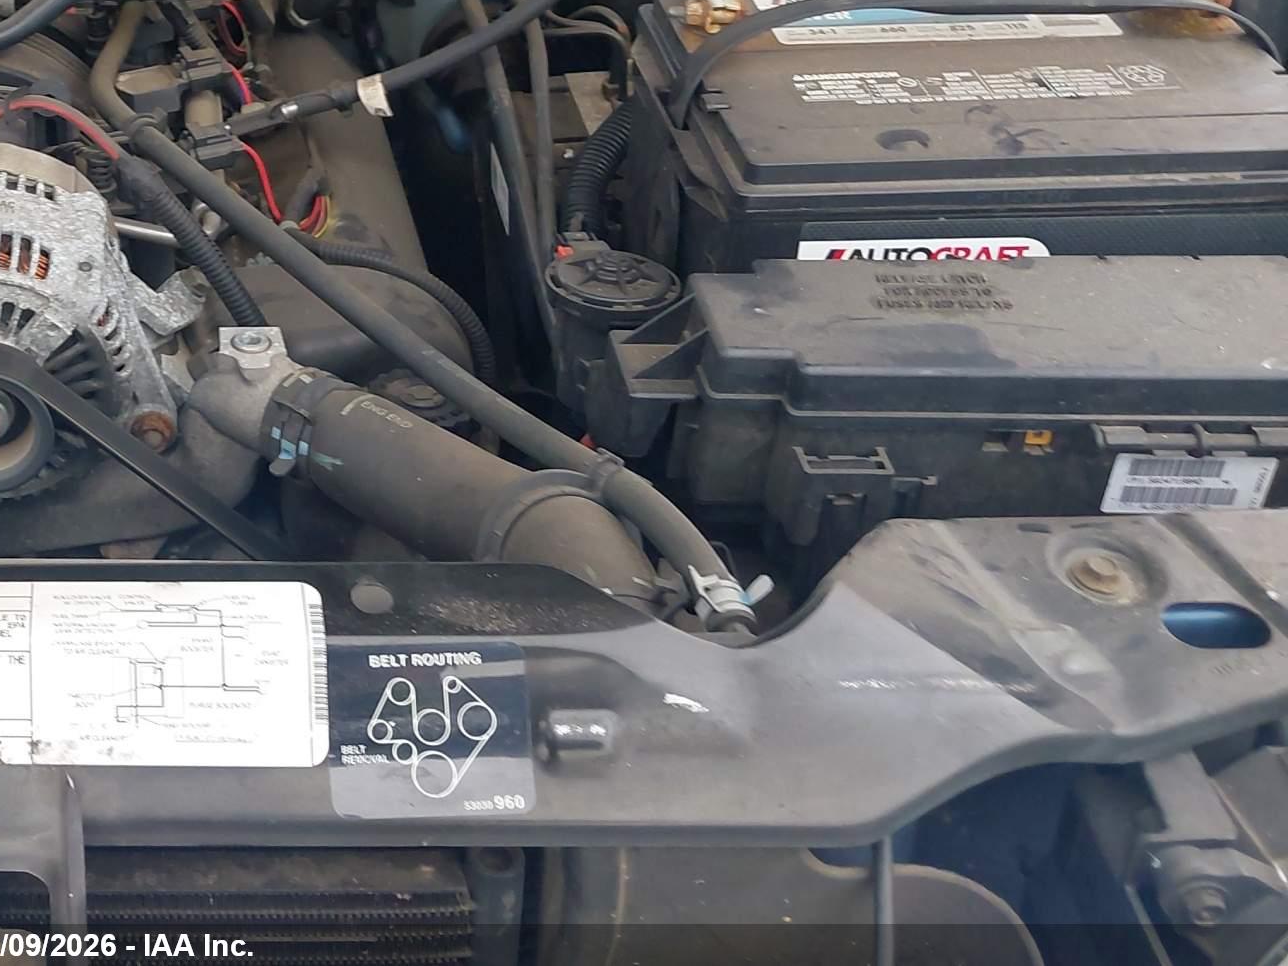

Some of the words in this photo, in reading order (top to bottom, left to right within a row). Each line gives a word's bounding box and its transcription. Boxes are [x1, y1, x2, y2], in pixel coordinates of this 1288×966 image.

[8, 655, 26, 664] THE
[368, 653, 408, 669] BELT
[411, 650, 483, 667] ROUTING
[340, 744, 367, 755] BELT
[341, 754, 392, 765] REMOVAL
